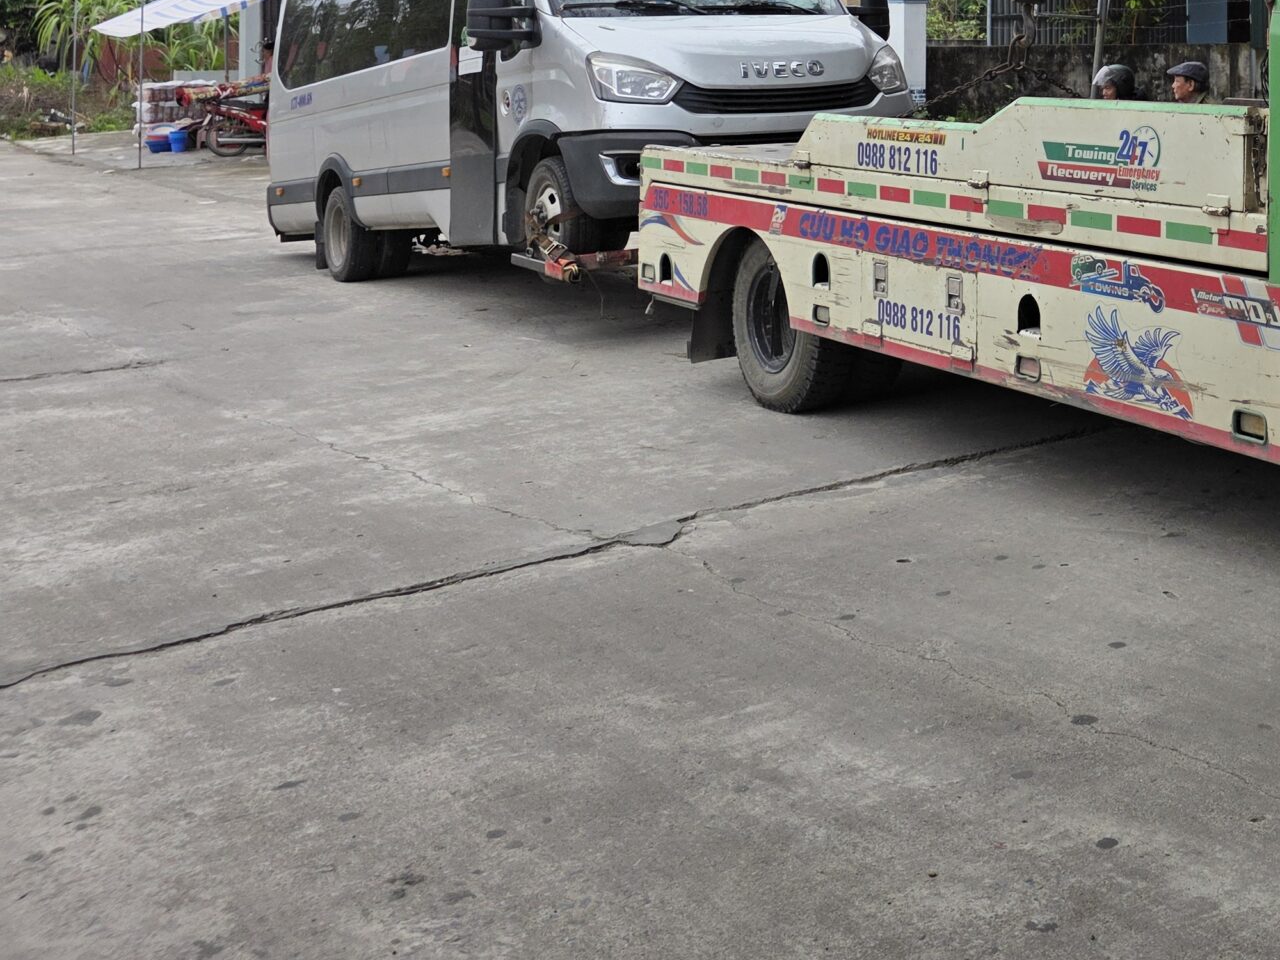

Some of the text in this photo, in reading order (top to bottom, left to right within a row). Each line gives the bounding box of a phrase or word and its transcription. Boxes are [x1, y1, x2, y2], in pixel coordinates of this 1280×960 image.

[740, 59, 825, 79] IVECO
[867, 128, 897, 140] HOTLINE
[858, 142, 938, 175] 0988 812 116
[1065, 145, 1116, 165] Towing
[1047, 164, 1115, 185] Recovery
[1118, 166, 1160, 181] Emergency
[1131, 180, 1158, 192] Services
[653, 189, 669, 210] 35C
[679, 192, 708, 217] 158.58
[875, 225, 929, 259] GIAO
[1197, 291, 1222, 302] Motor
[878, 298, 960, 342] 0988 812 116
